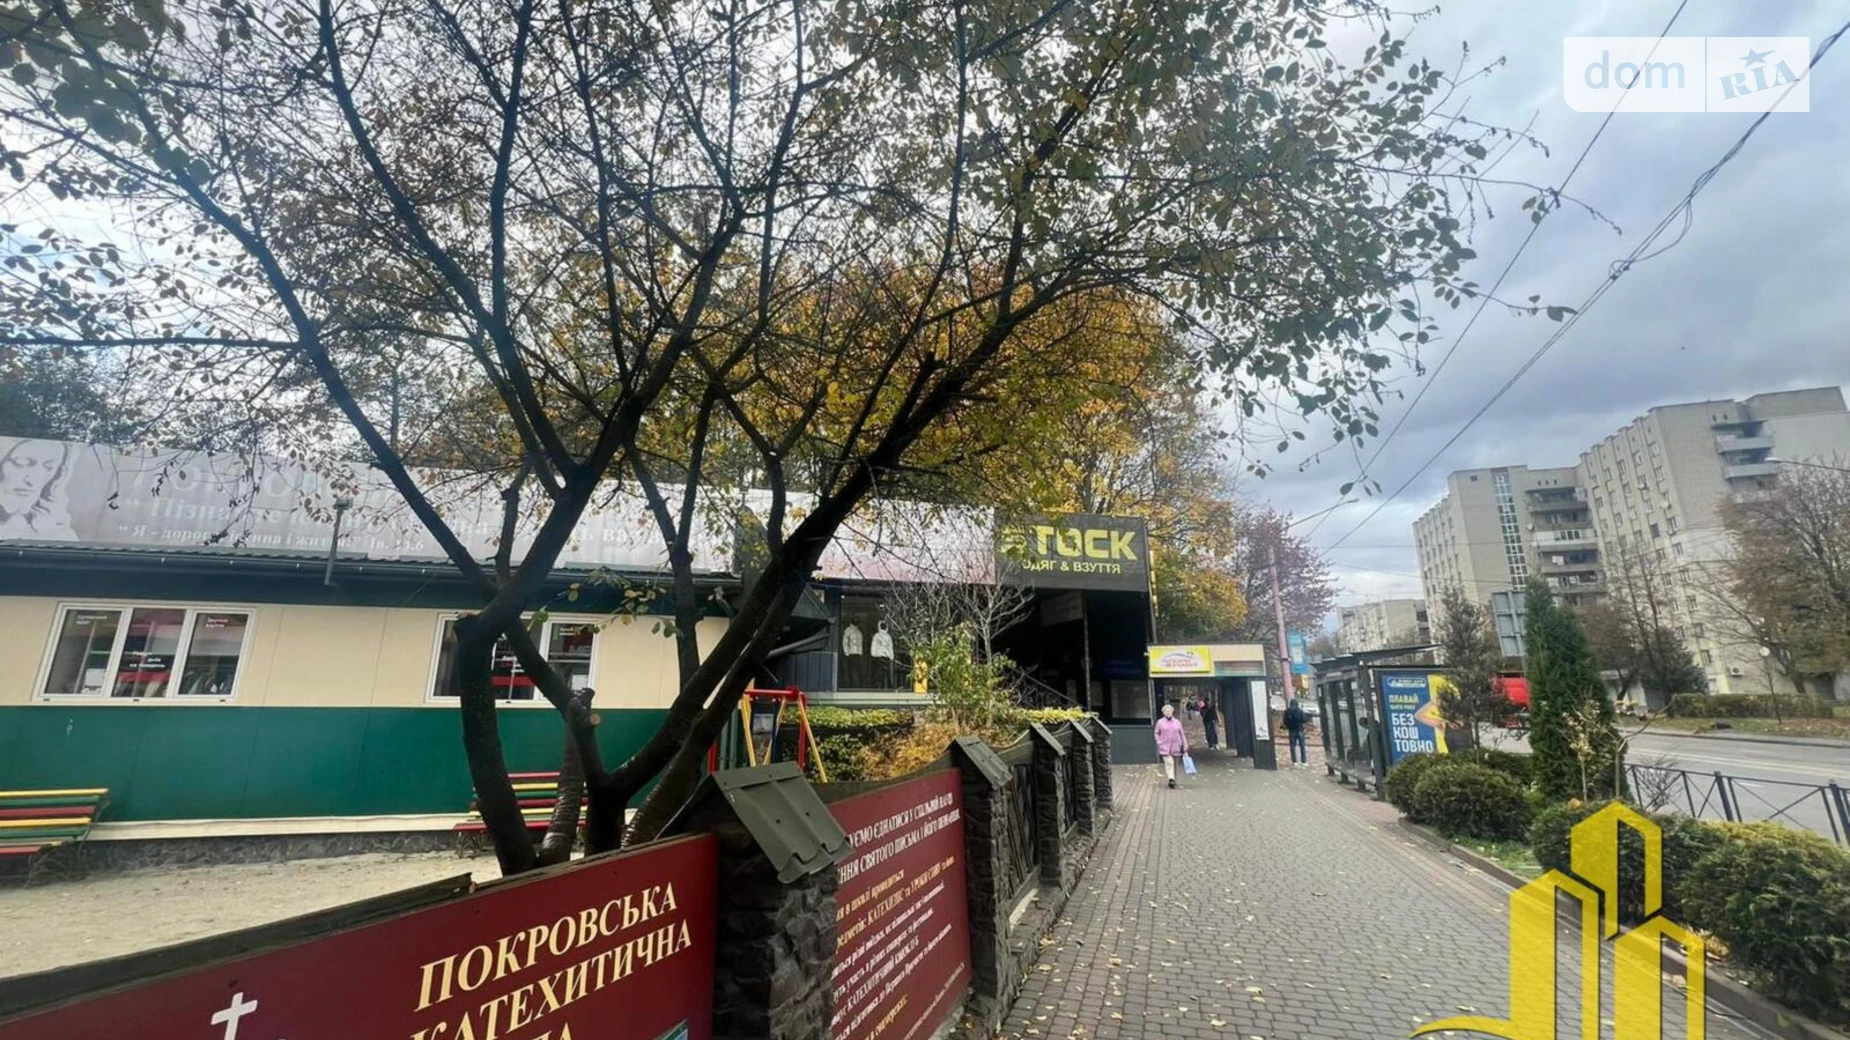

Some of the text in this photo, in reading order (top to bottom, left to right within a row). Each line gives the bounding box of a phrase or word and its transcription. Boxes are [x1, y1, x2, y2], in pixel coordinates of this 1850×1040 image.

[1060, 560, 1070, 571] &
[1073, 561, 1121, 574] ВЗУТТЯ
[1388, 693, 1419, 704] ПЛАВАЙ
[1391, 713, 1415, 726] БЕЗ
[1393, 726, 1419, 739] КОШ
[1394, 739, 1434, 753] ТОВНО
[860, 843, 895, 872] СВЯТОГО
[413, 881, 678, 1012] ПОКРОВСЬКА
